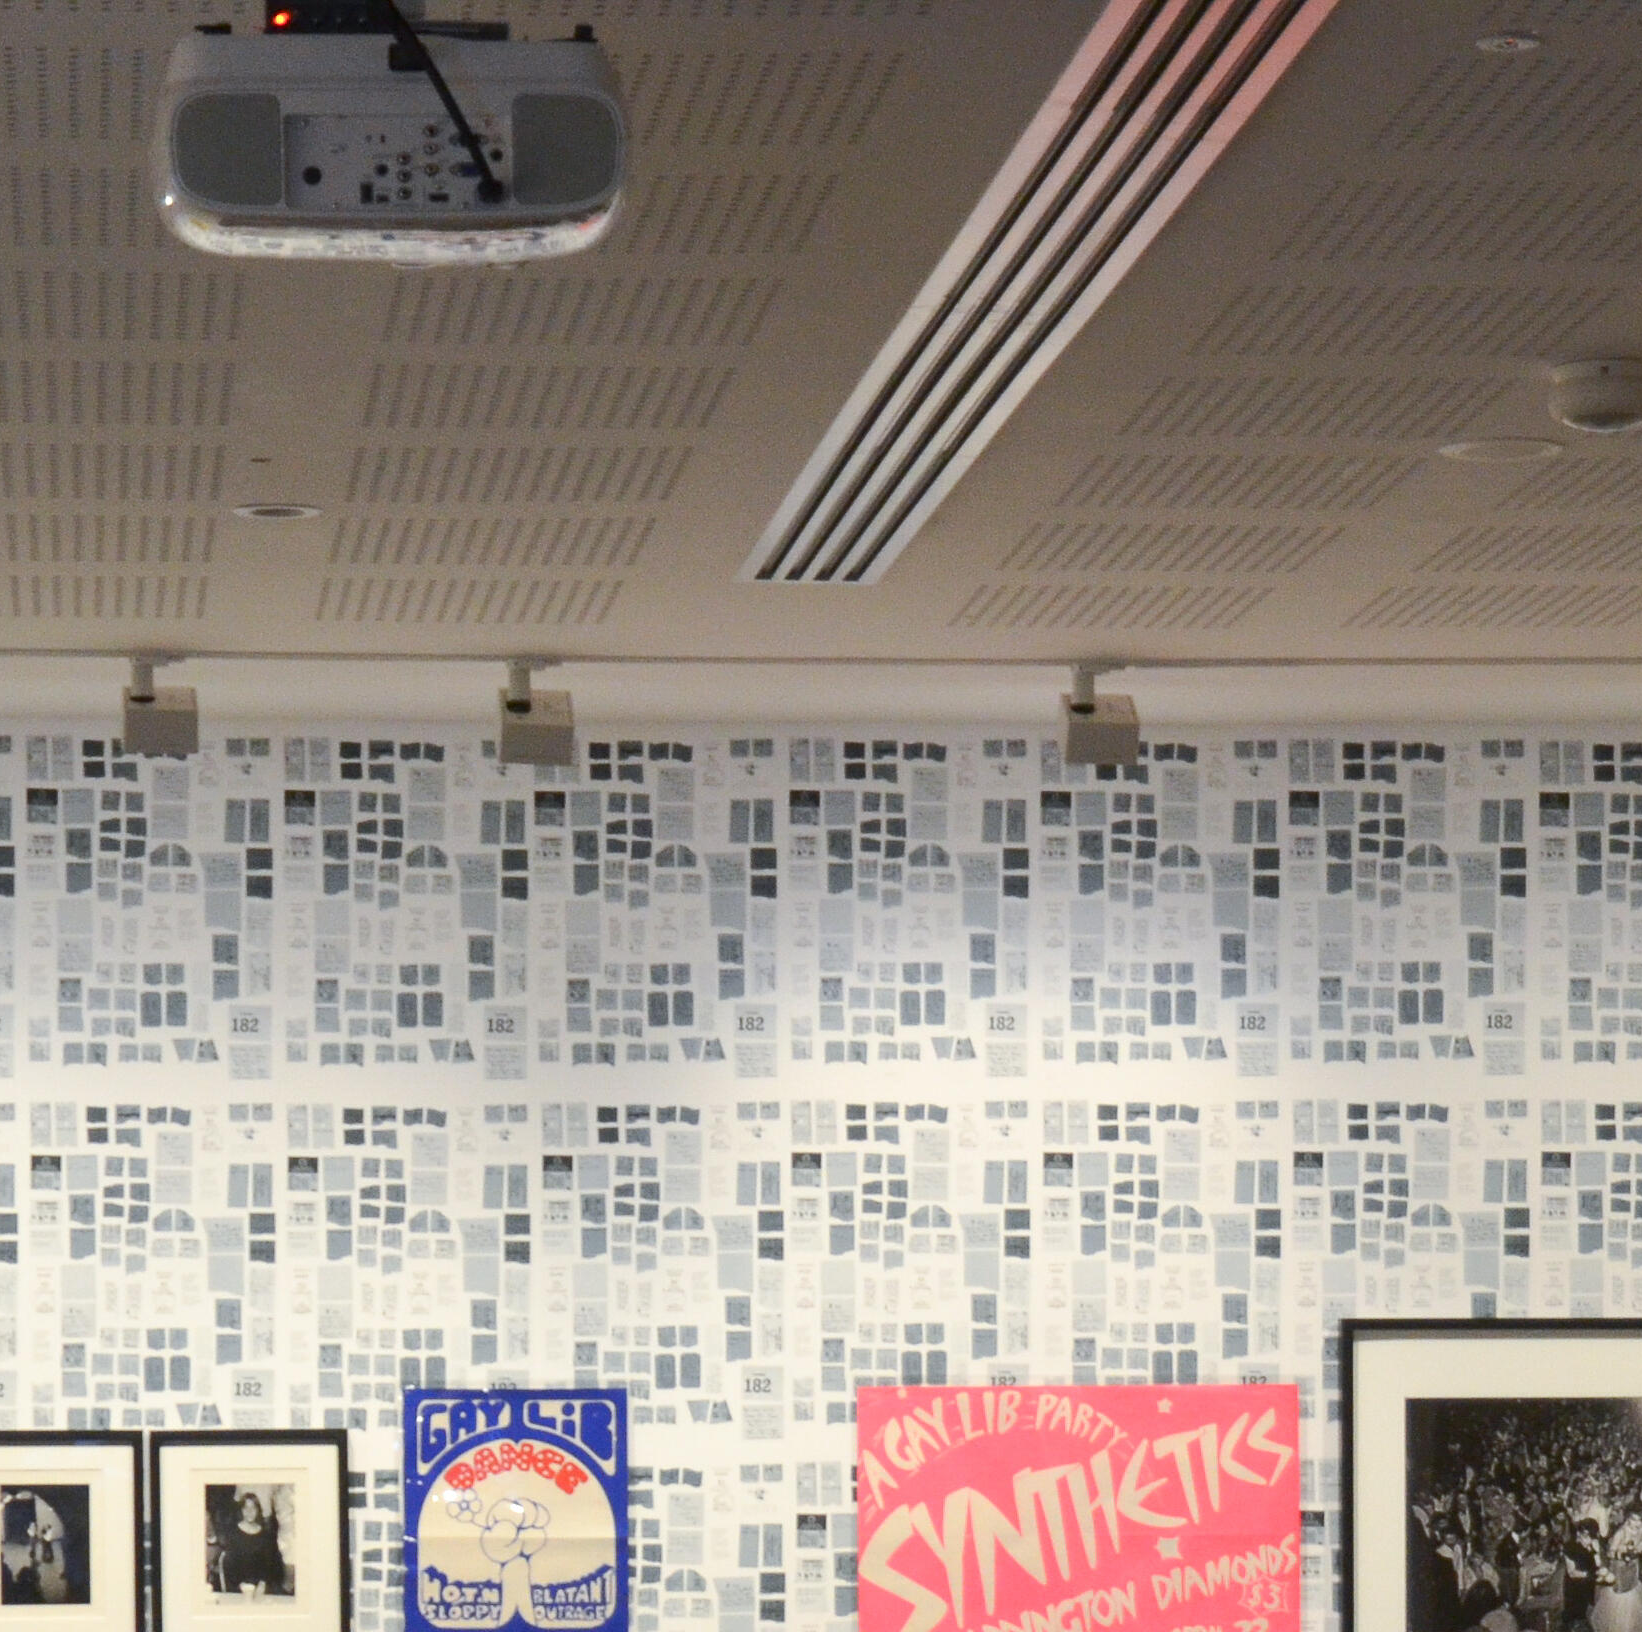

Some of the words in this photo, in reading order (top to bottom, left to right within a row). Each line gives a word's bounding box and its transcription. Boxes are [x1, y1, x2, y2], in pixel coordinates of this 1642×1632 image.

[231, 1017, 259, 1033] 182
[487, 1018, 515, 1034] 182
[737, 1016, 765, 1032] 182
[988, 1016, 1016, 1032] 182
[1239, 1015, 1267, 1031] 182
[1486, 1014, 1514, 1030] 182
[234, 1382, 263, 1397] 182
[744, 1378, 772, 1394] 182
[419, 1401, 509, 1464] GAY
[860, 1449, 899, 1509] A
[883, 1396, 952, 1471] GAY
[955, 1390, 1021, 1441] LIB
[1035, 1393, 1131, 1451] PARTY
[443, 1442, 589, 1495] DANCE
[1151, 1533, 1297, 1611] DIAMONDS
[532, 1567, 616, 1604] BLATANT
[425, 1604, 502, 1621] SLOPPY
[534, 1605, 607, 1621] OUTRAGE
